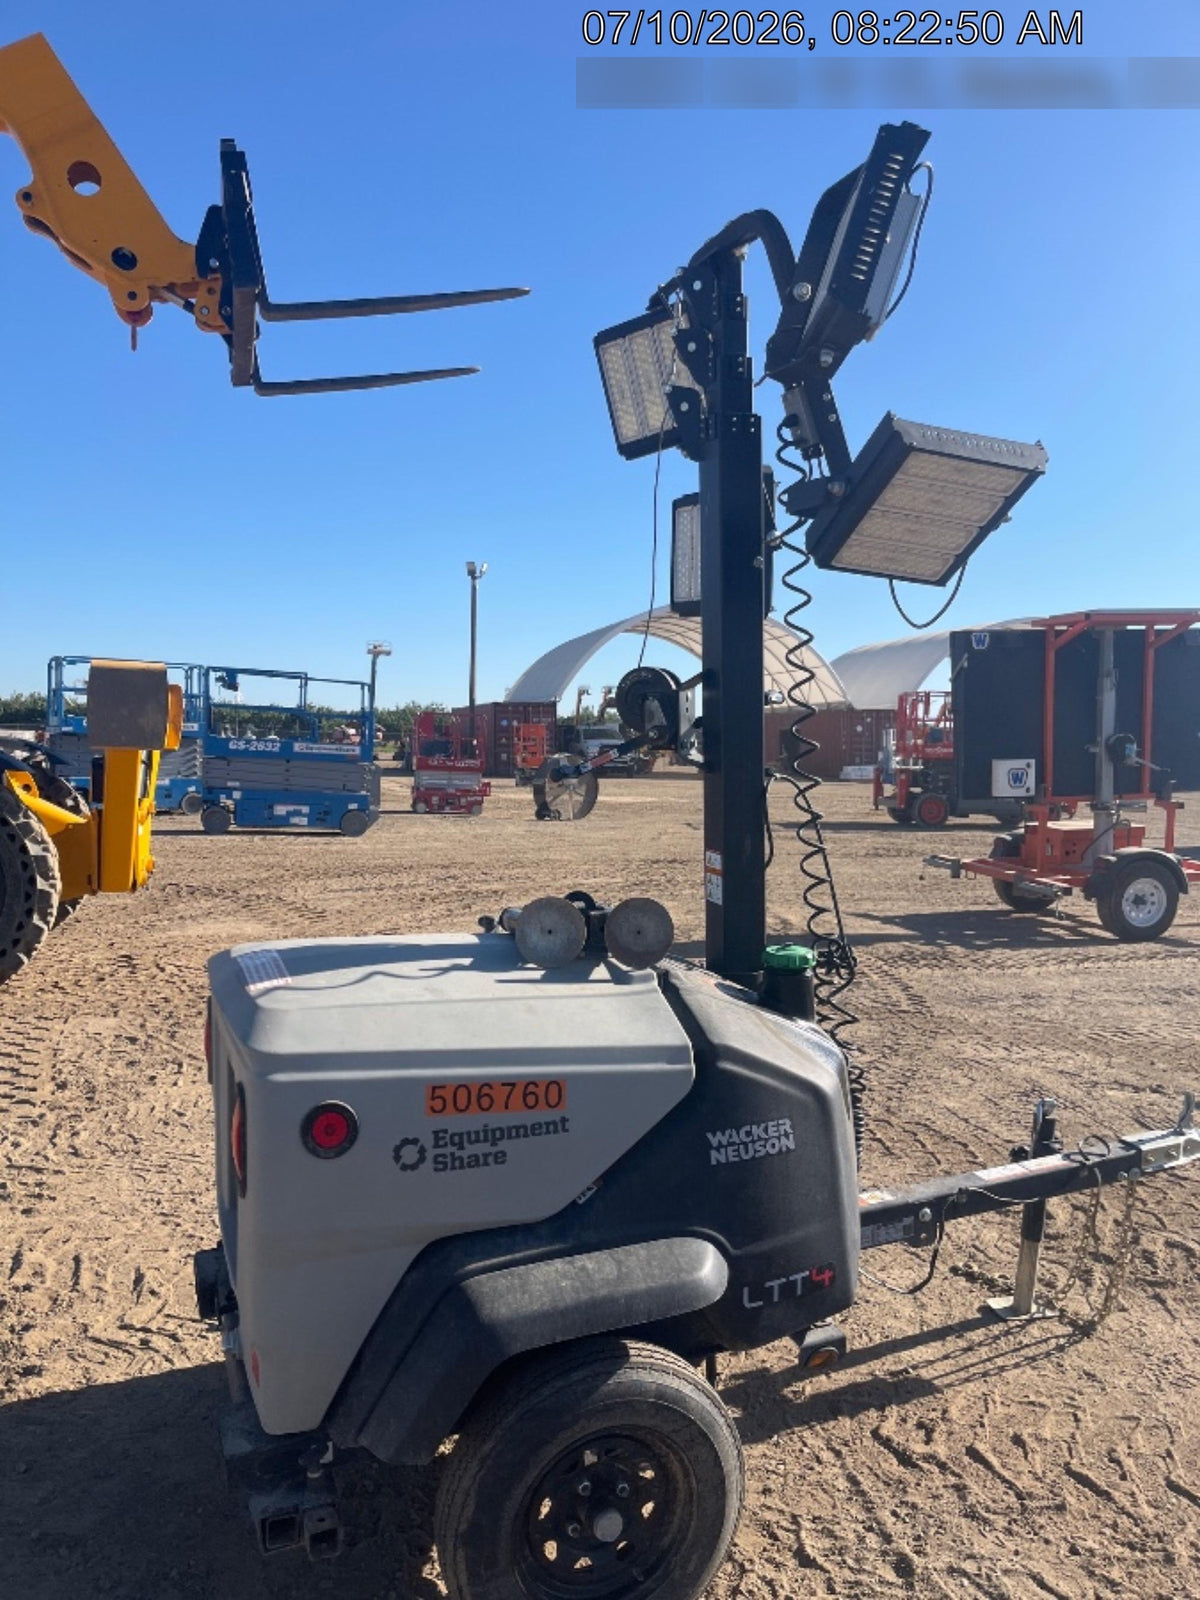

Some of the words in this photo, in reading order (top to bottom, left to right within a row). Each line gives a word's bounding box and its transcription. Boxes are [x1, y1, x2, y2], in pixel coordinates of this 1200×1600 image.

[429, 1080, 563, 1114] 506760
[432, 1116, 570, 1150] Equipment
[706, 1118, 794, 1147] WACKER
[433, 1150, 508, 1172] Share
[710, 1134, 796, 1166] NEUSON
[742, 1267, 834, 1309] LTT4
